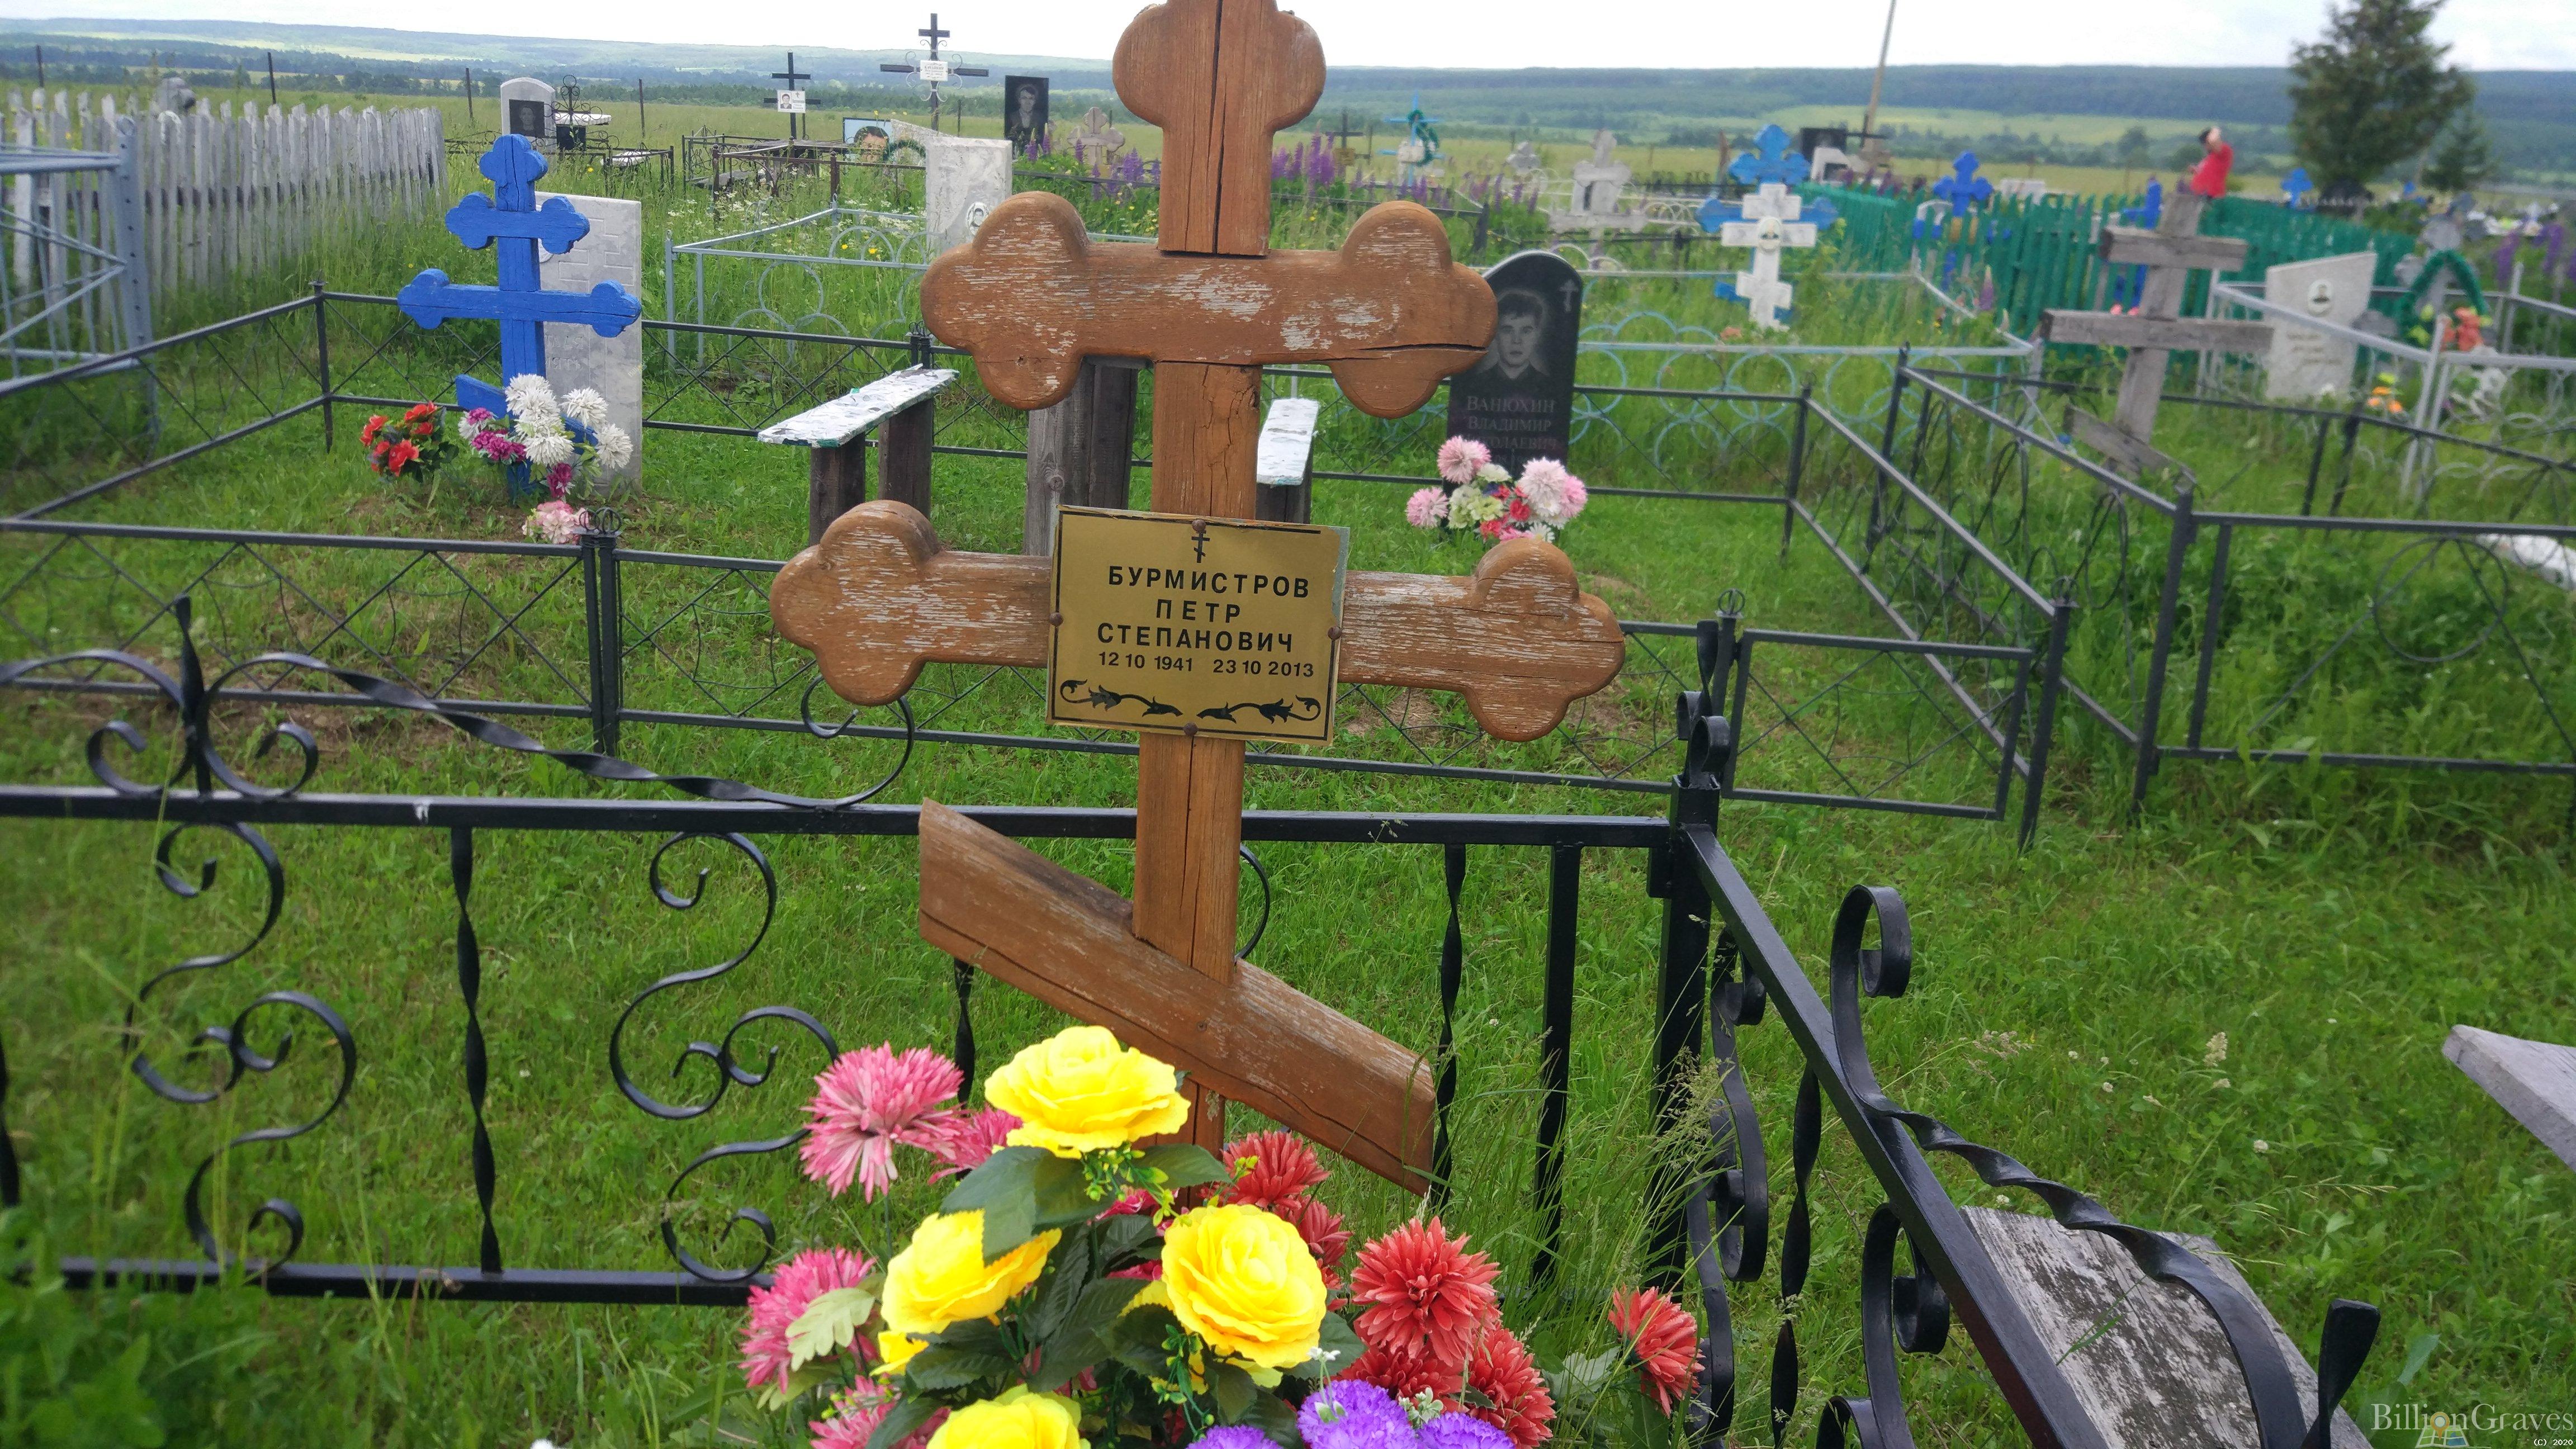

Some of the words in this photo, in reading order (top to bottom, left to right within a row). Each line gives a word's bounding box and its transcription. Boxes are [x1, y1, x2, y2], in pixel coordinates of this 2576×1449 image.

[1467, 396, 1556, 413] ВАНЮХИН
[1468, 416, 1552, 432] ВЛАДИМИР
[1467, 434, 1557, 450] ОЛАЕВИЧ
[1109, 565, 1309, 598] БУРМИСТРОВ
[1156, 599, 1240, 623] ПЕТР
[1097, 622, 1292, 653] СТЕПАНОВИЧ
[1098, 651, 1119, 666] 12
[1125, 654, 1145, 669] 10
[1154, 656, 1192, 671] 1941
[1213, 659, 1237, 674] 23
[1242, 660, 1261, 675] 10
[1268, 661, 1314, 678] 2013
